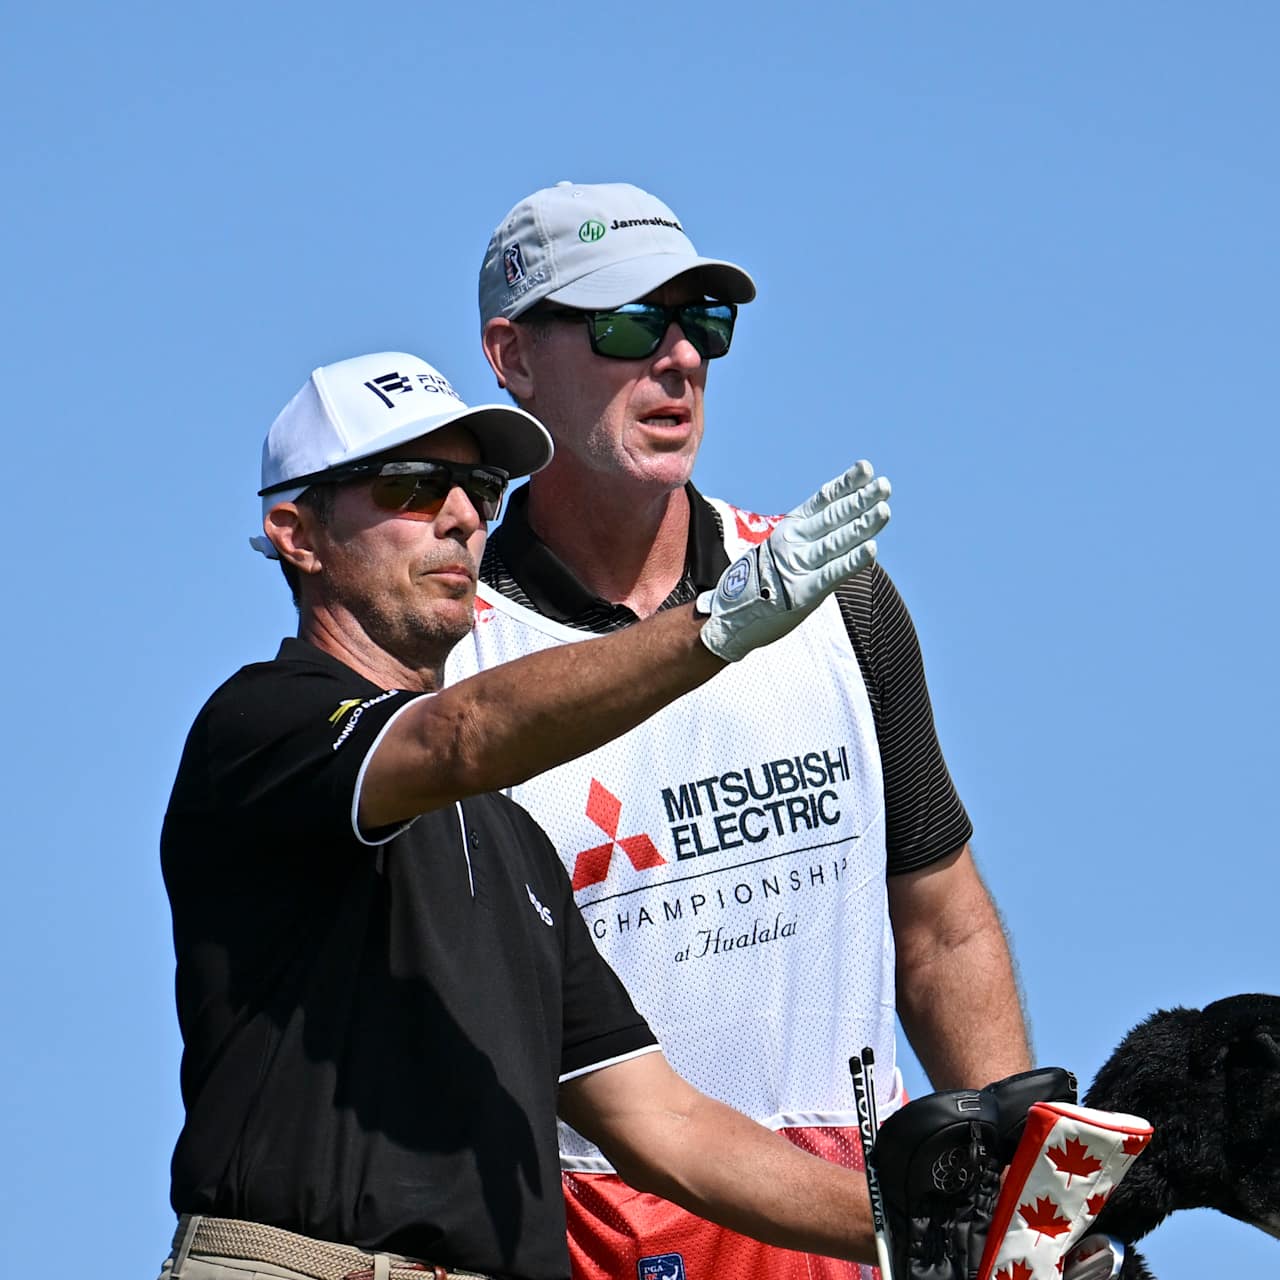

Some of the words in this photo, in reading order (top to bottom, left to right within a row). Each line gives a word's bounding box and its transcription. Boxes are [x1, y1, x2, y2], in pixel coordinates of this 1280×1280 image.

[333, 707, 363, 751] AGNICO
[661, 746, 850, 822] MITSUBISHI
[671, 790, 841, 861] ELECTRIC
[674, 944, 691, 963] at
[694, 912, 798, 959] Hualalai
[643, 1264, 664, 1274] PGA
